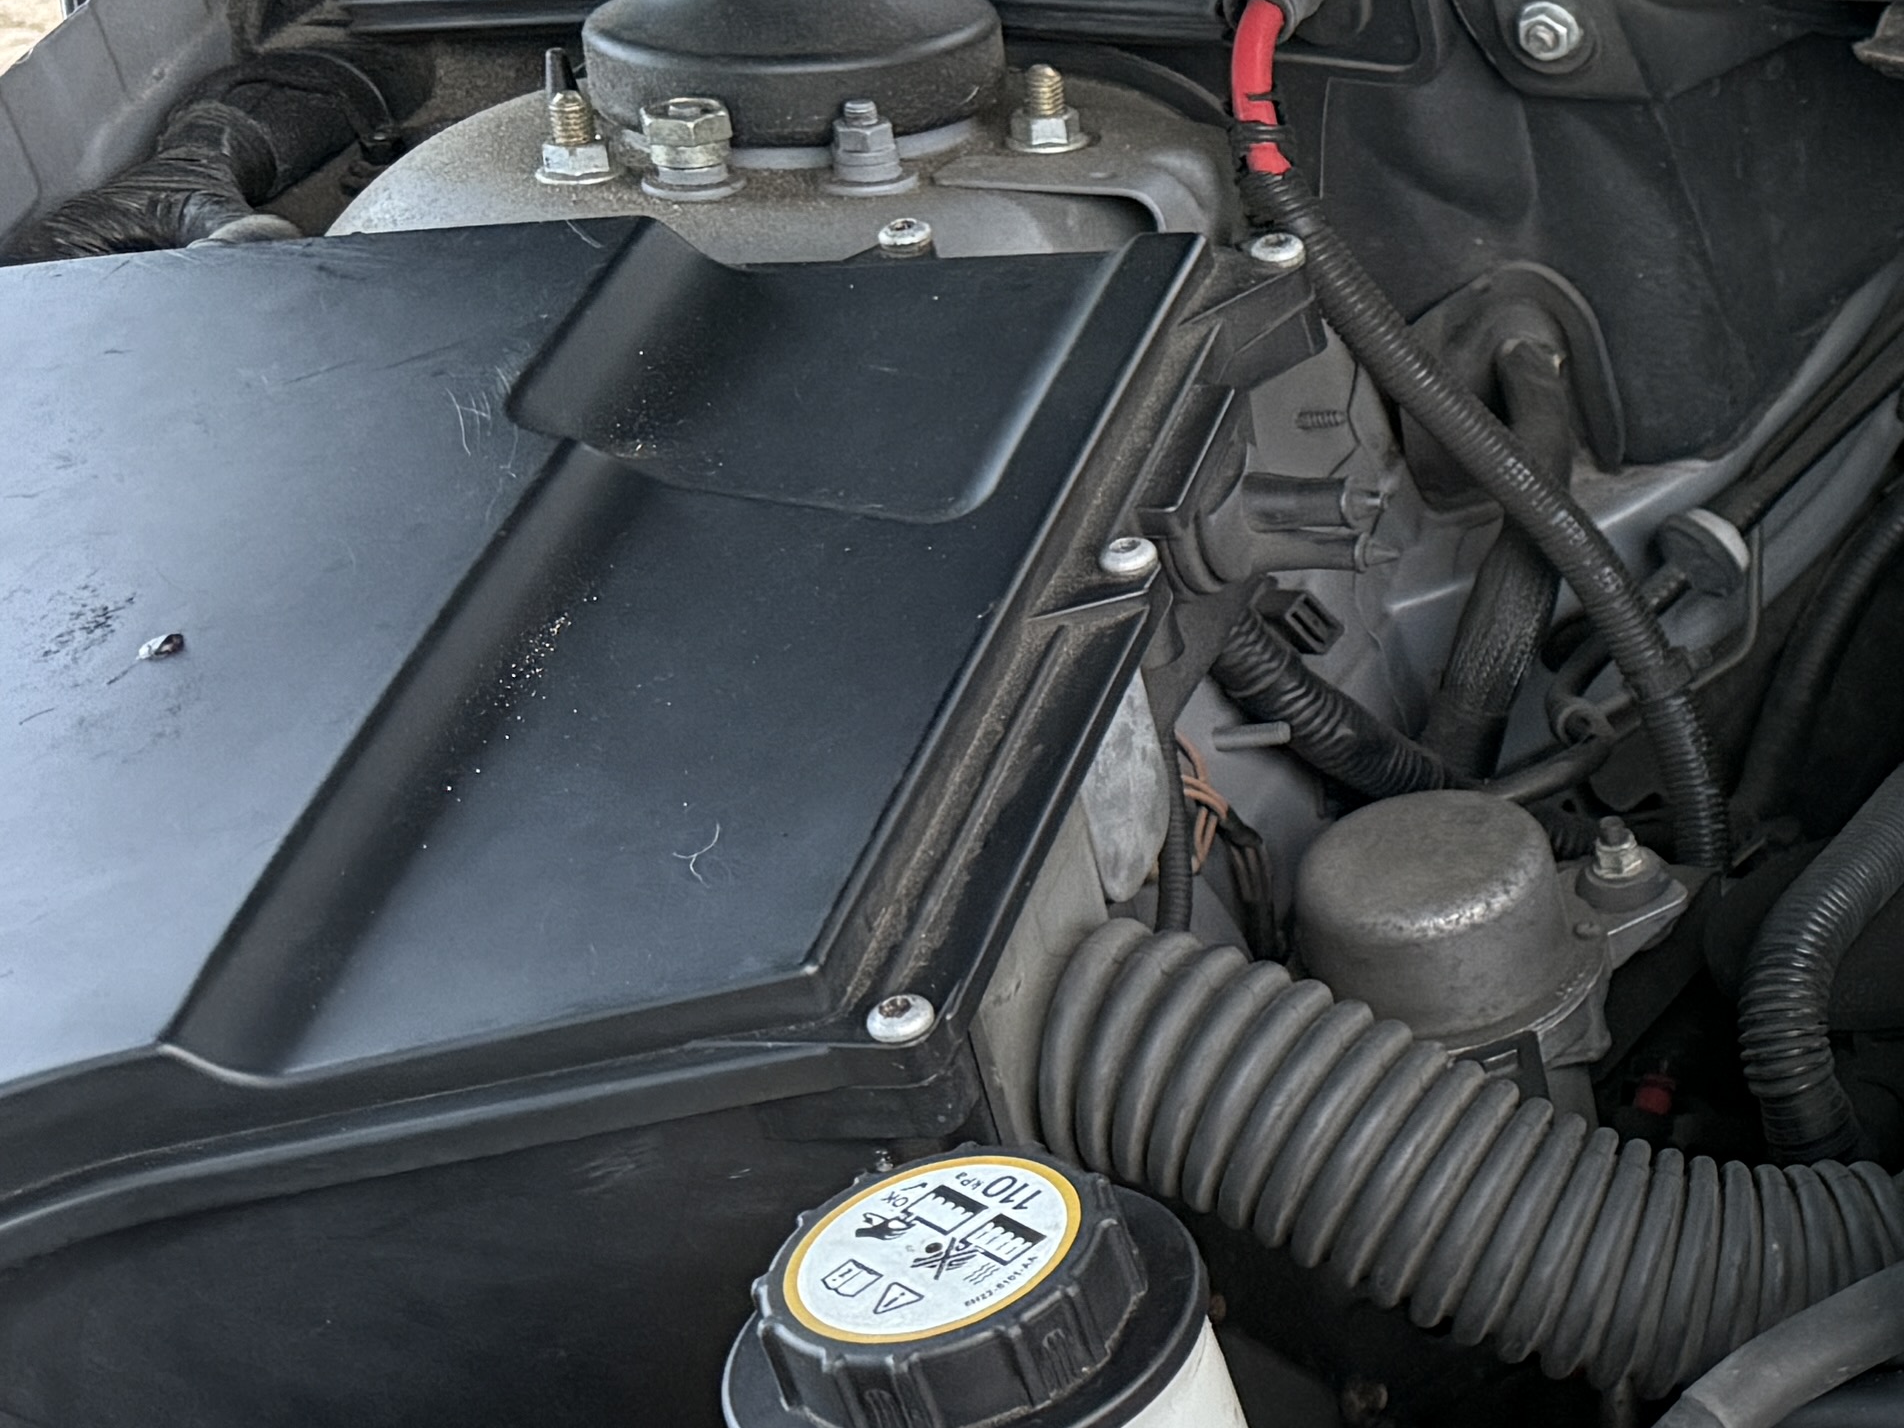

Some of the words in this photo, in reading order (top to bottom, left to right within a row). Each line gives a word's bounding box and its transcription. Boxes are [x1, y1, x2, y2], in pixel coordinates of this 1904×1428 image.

[953, 1171, 984, 1192] kPa
[881, 1191, 909, 1209] OK
[983, 1175, 1041, 1210] 110
